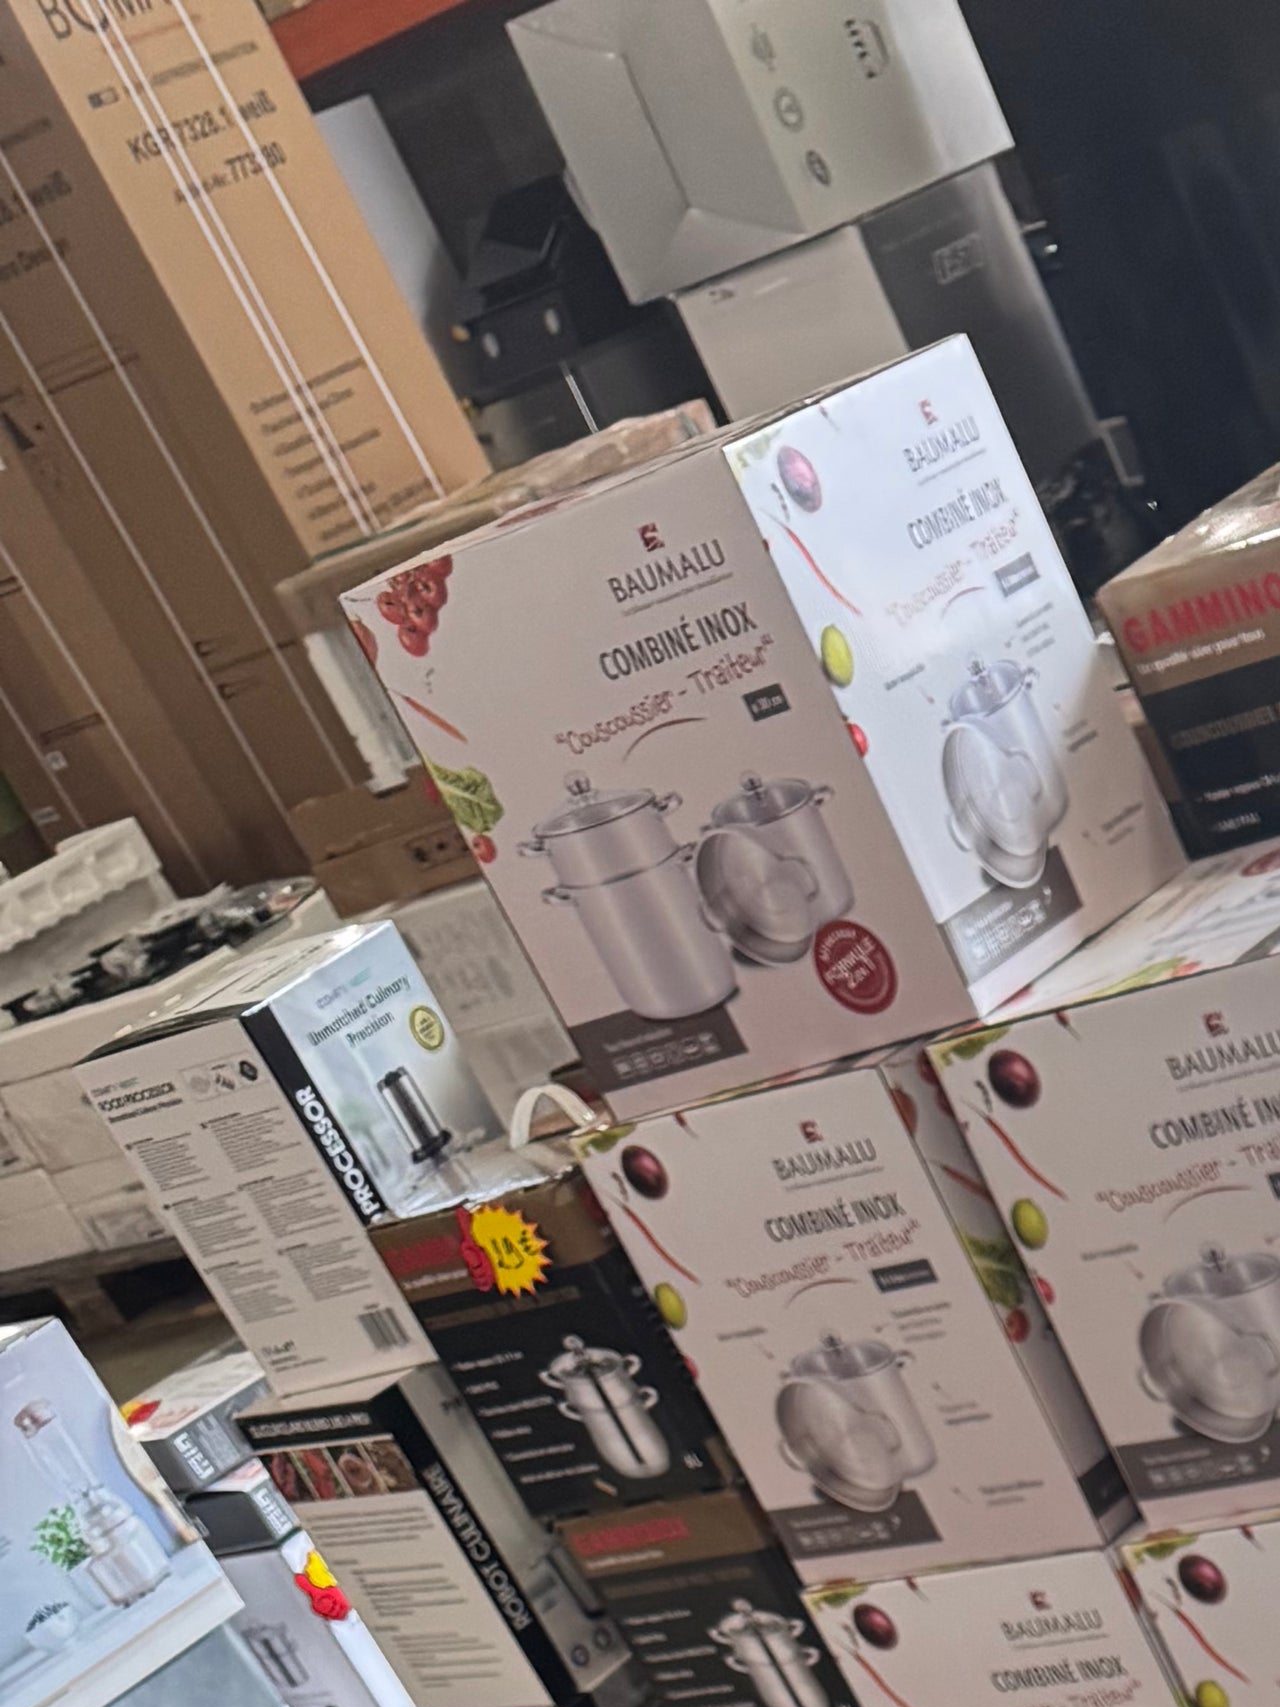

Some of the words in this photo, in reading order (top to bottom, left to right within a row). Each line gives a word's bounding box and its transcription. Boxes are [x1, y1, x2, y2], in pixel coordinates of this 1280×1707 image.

[606, 538, 726, 603] BAUMALU
[599, 614, 700, 681] COMBINÉ
[696, 601, 758, 647] INOX
[296, 1085, 382, 1218] PROCESSOR
[1149, 1097, 1254, 1151] COMBINÉ
[771, 1138, 878, 1182] BAUMALU
[763, 1197, 856, 1244] COMBINÉ
[850, 1192, 908, 1227] INOX
